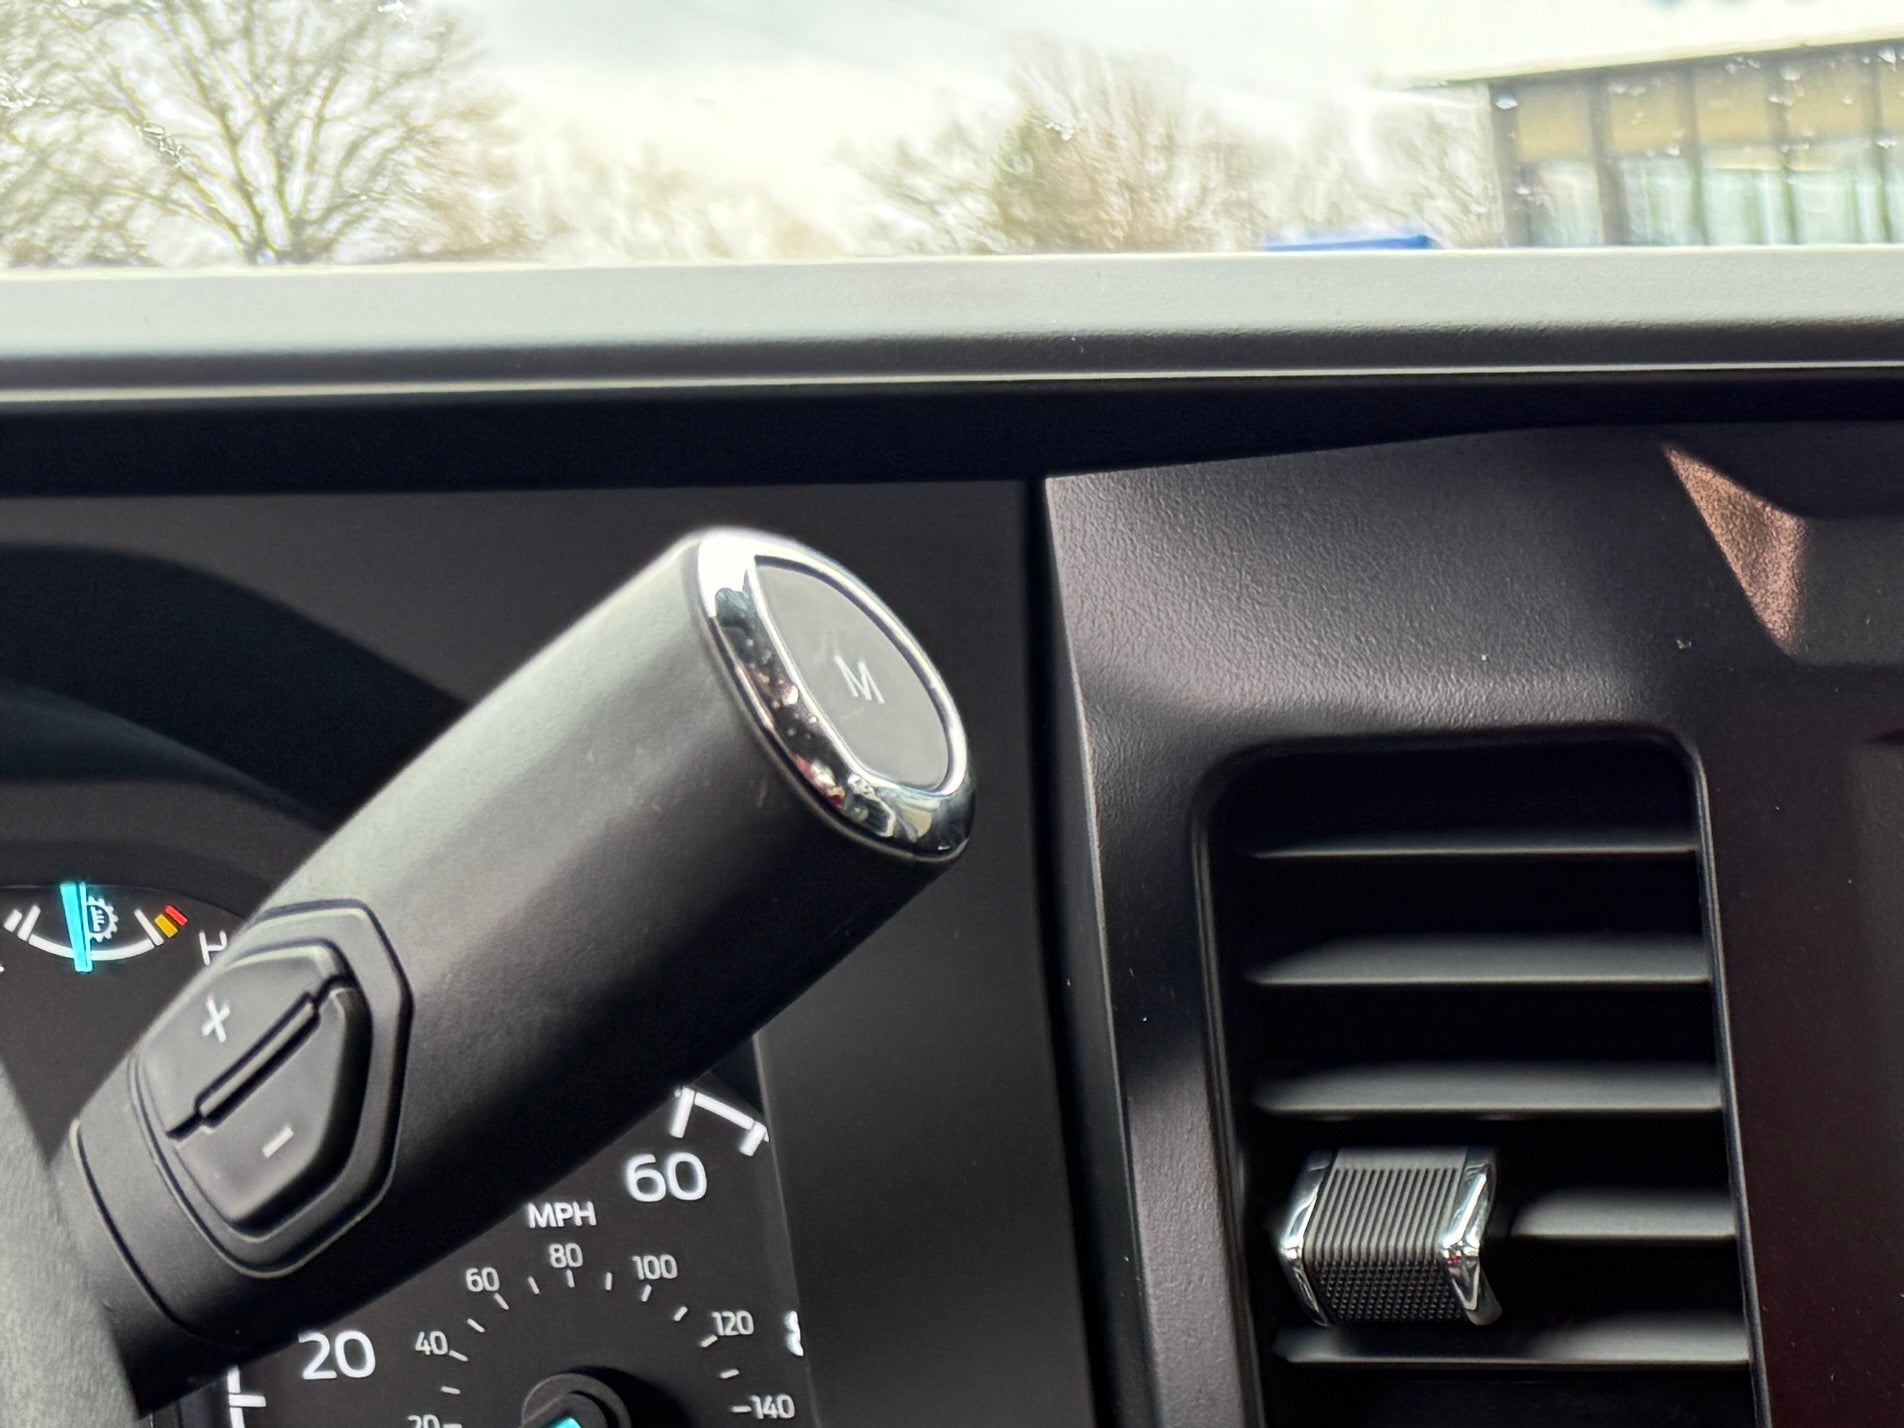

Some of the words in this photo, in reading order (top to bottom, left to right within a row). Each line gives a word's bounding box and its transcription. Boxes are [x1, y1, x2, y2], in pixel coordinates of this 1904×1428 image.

[833, 655, 885, 704] M
[624, 1152, 708, 1202] 60
[527, 1201, 597, 1228] MPH
[549, 1243, 583, 1269] 80
[632, 1254, 678, 1280] 100
[465, 1266, 500, 1294] 60
[712, 1310, 754, 1336] 120
[298, 1329, 376, 1380] 20
[414, 1330, 448, 1356] 40
[751, 1394, 795, 1420] 140
